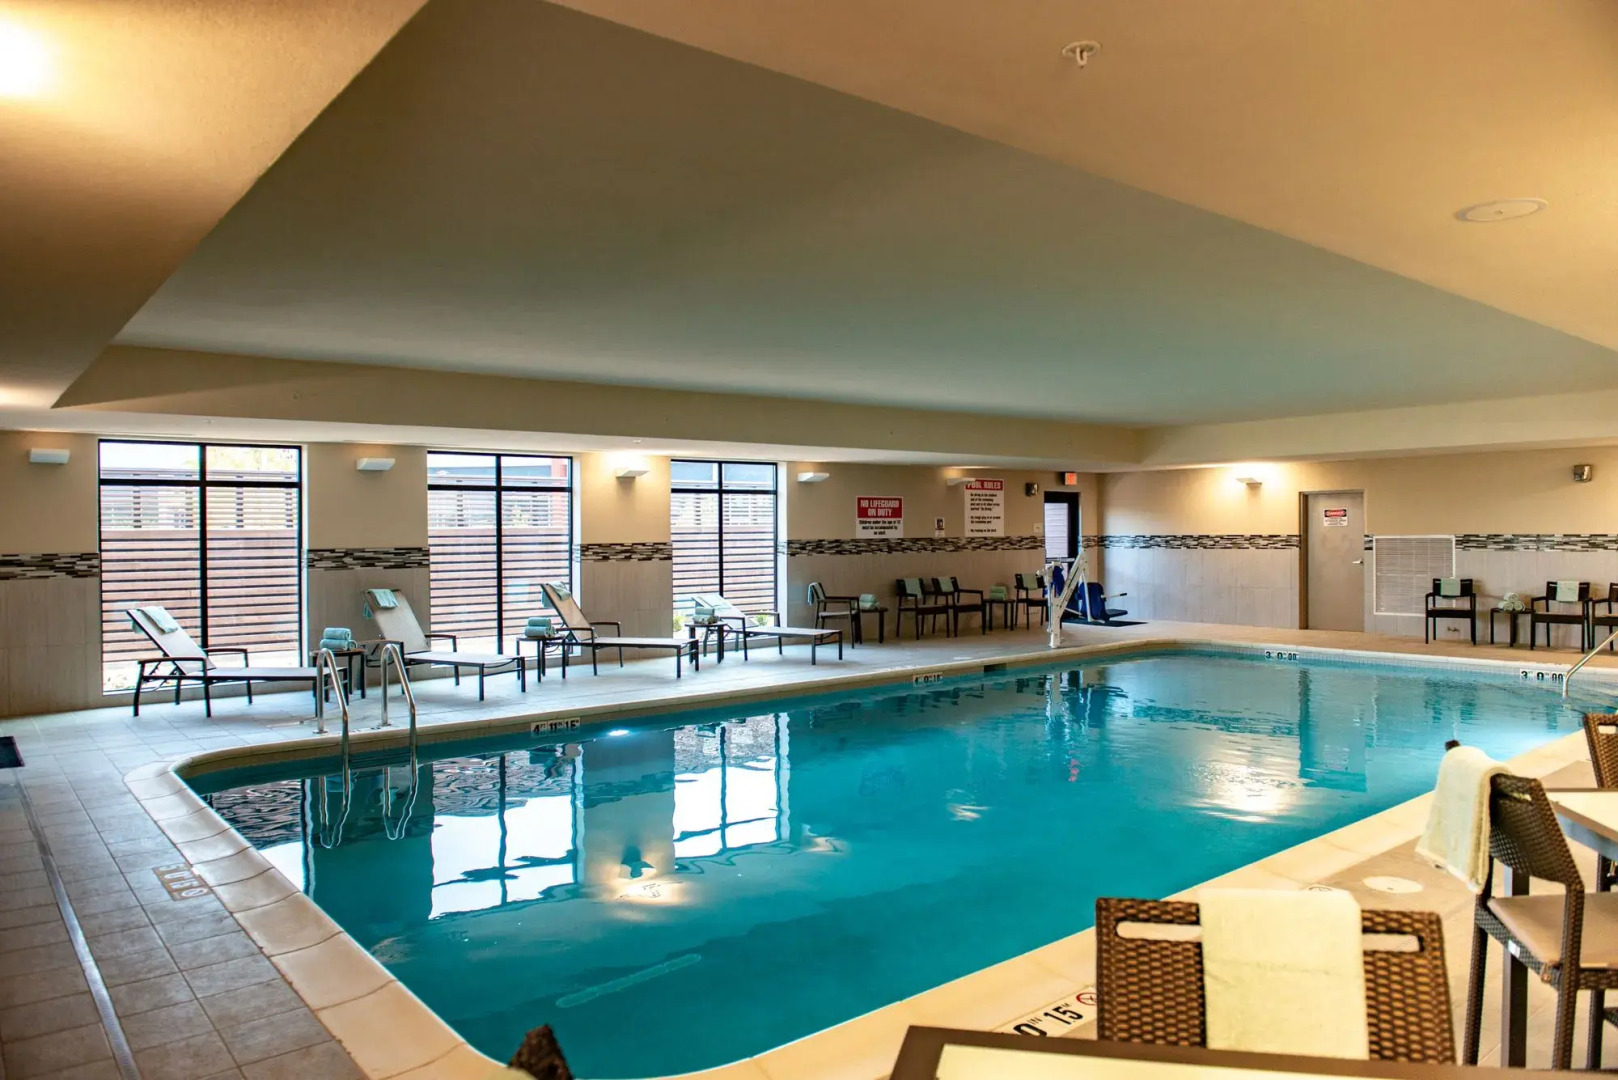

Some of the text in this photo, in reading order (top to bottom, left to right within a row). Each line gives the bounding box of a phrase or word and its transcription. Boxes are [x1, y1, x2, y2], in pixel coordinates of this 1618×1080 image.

[860, 499, 900, 508] NO LIFEGUARD
[867, 508, 892, 517] ON DUTY
